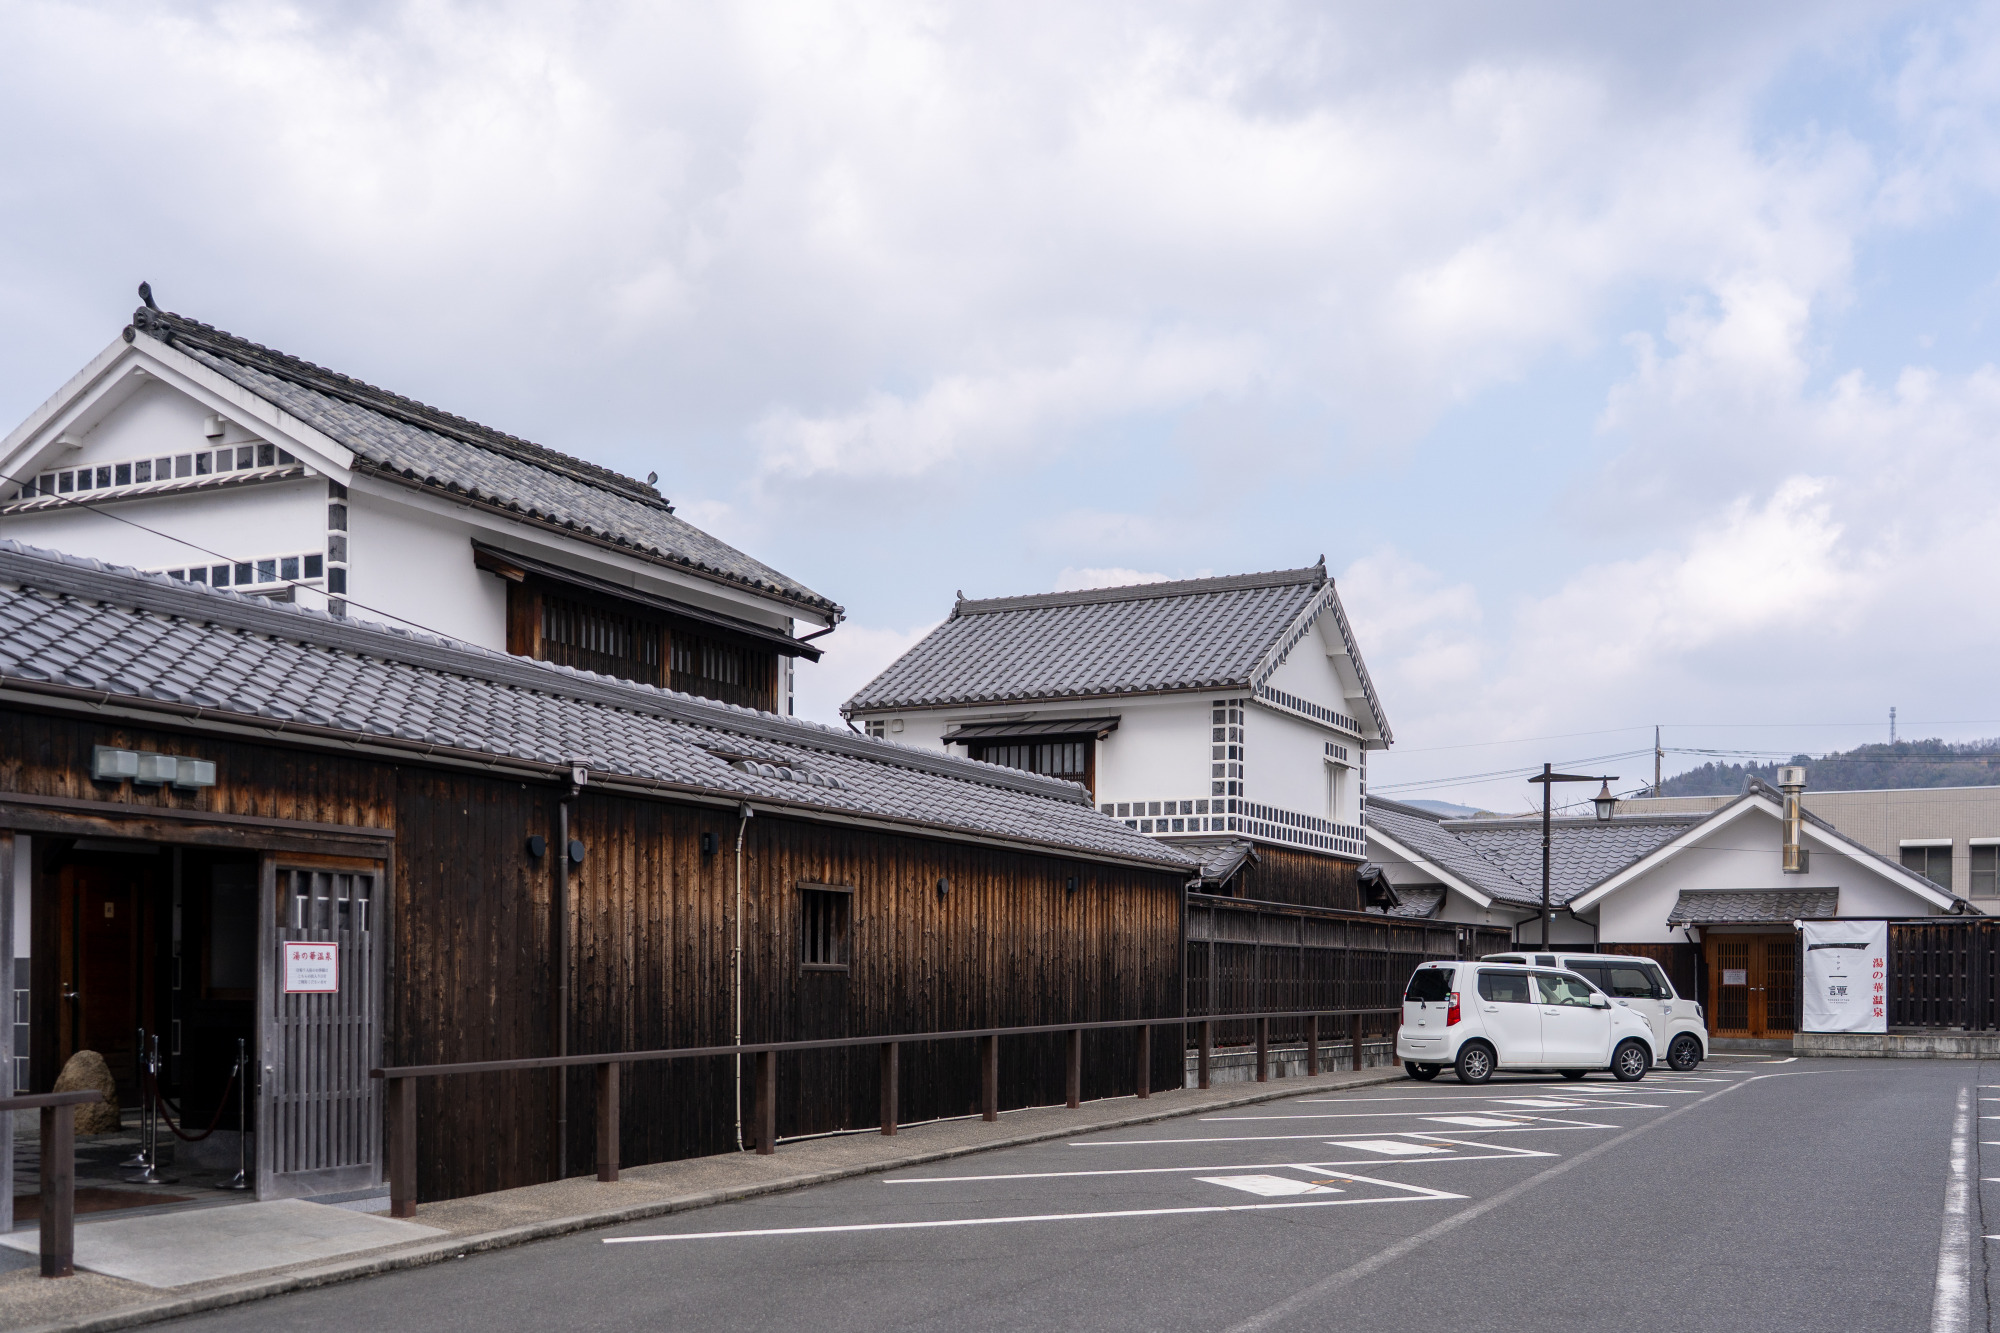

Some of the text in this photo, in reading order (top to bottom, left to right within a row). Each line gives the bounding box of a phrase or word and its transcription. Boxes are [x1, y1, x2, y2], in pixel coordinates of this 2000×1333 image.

[293, 951, 332, 960] 湯の華温泉
[1873, 958, 1883, 1017] 湯の華温泉
